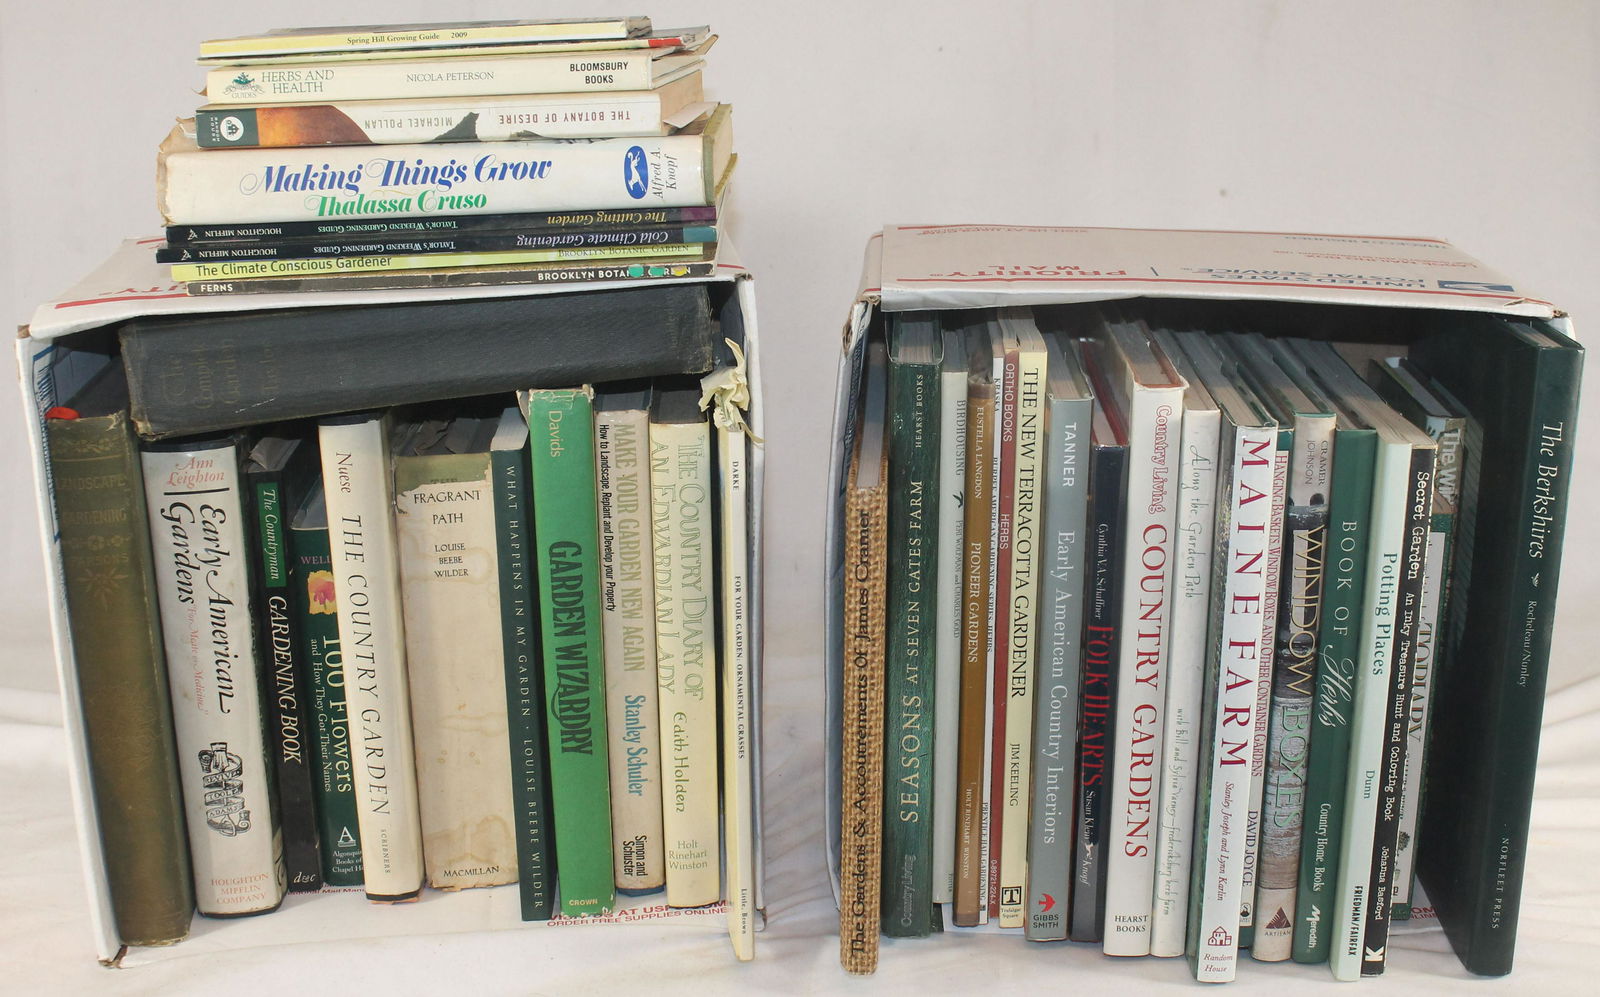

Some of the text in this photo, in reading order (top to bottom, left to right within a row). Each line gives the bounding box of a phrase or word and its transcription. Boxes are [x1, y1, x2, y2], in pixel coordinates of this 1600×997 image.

[347, 31, 468, 45] Spring Hill Growing Guide 2009
[262, 69, 335, 82] HERBS AND
[406, 71, 494, 83] NICOLA PETERSON
[569, 61, 629, 72] BLOOMSBURY
[585, 74, 614, 84] BOOKS
[272, 81, 323, 94] HEALTH
[364, 117, 453, 130] MICHAEL POLLAN
[499, 110, 630, 125] THE BOTANY OF DESIRE
[239, 154, 552, 196] Making Things Grow
[304, 190, 487, 217] Thalassa Cruso
[547, 211, 666, 225] The Cutting Garden
[517, 231, 669, 247] Cold Climate Gardening
[196, 256, 392, 277] The Climate Conscious Gardener
[200, 270, 595, 293] FERNS BROOKLYN
[599, 424, 610, 439] How
[601, 440, 608, 449] to
[175, 457, 213, 471] Ann
[1000, 363, 1015, 550] ORTHO BOOKS HERBS
[166, 471, 225, 489] Leighton
[732, 461, 740, 491] DARKE
[414, 490, 481, 504] FRAGRANT
[1528, 422, 1564, 560] The Berkshires
[432, 513, 464, 525] PATH
[602, 492, 613, 520] Replant
[263, 490, 280, 580] The Countryman
[603, 520, 612, 533] and
[1011, 367, 1039, 699] THE NEW TERRACOTTA GARDENER
[1407, 471, 1430, 580] Secret Garden
[160, 501, 200, 604] Gardens
[434, 543, 466, 553] LOUISE
[438, 556, 464, 565] BEEBE
[604, 535, 614, 563] Develop
[614, 424, 645, 672] MAKE YOUR GARDEN NEW AGAIN
[434, 568, 469, 578] WILDER
[547, 409, 594, 756] Davids GARDEN WIZARDRY
[605, 563, 614, 581] your
[195, 504, 239, 714] Early American
[605, 582, 616, 612] Property
[735, 597, 743, 621] YOUR
[967, 543, 982, 663] PIONEER GARDENS
[1218, 438, 1272, 769] MAINE FARM
[335, 452, 391, 815] Nuese THE COUNTRY GARDEN
[1042, 422, 1077, 845] TANNER Early American Country Interiors
[1318, 521, 1358, 728] BOOK OF Herbs
[899, 480, 923, 823] SEASONS AT SEVEN GATES FARM
[268, 596, 302, 765] GARDENING BOOK
[506, 465, 544, 908] WHAT HAPPENS IN MY GARDEN LOUISE BEEBE WILDER
[1123, 523, 1168, 858] COUNTRY GARDENS
[1274, 524, 1326, 829] WINDOW BOXES
[736, 664, 745, 721] ORNAMENTAL
[1081, 625, 1114, 788] FOLK HEARTS
[1384, 592, 1416, 821] An Inky Treasure Hunt and Coloring Book
[323, 635, 352, 793] 100 Flowers
[624, 694, 648, 797] Stanley Schuler
[737, 723, 745, 760] GRASSES
[852, 511, 871, 956] The Gardens & Accoutrements Of James Cramer
[673, 711, 691, 813] Edith Holden
[1347, 552, 1398, 956] Potting Places FRIEDMAN/FAIRFAX
[443, 865, 500, 878] MACMILLAN
[568, 898, 598, 906] CROWN
[546, 907, 729, 928] ORDER FREE SUPPLIES ONLINE
[1032, 914, 1060, 922] GIBBS
[1032, 921, 1059, 929] SMITH
[1114, 914, 1149, 924] HEARST
[1116, 923, 1147, 933] BOOKS
